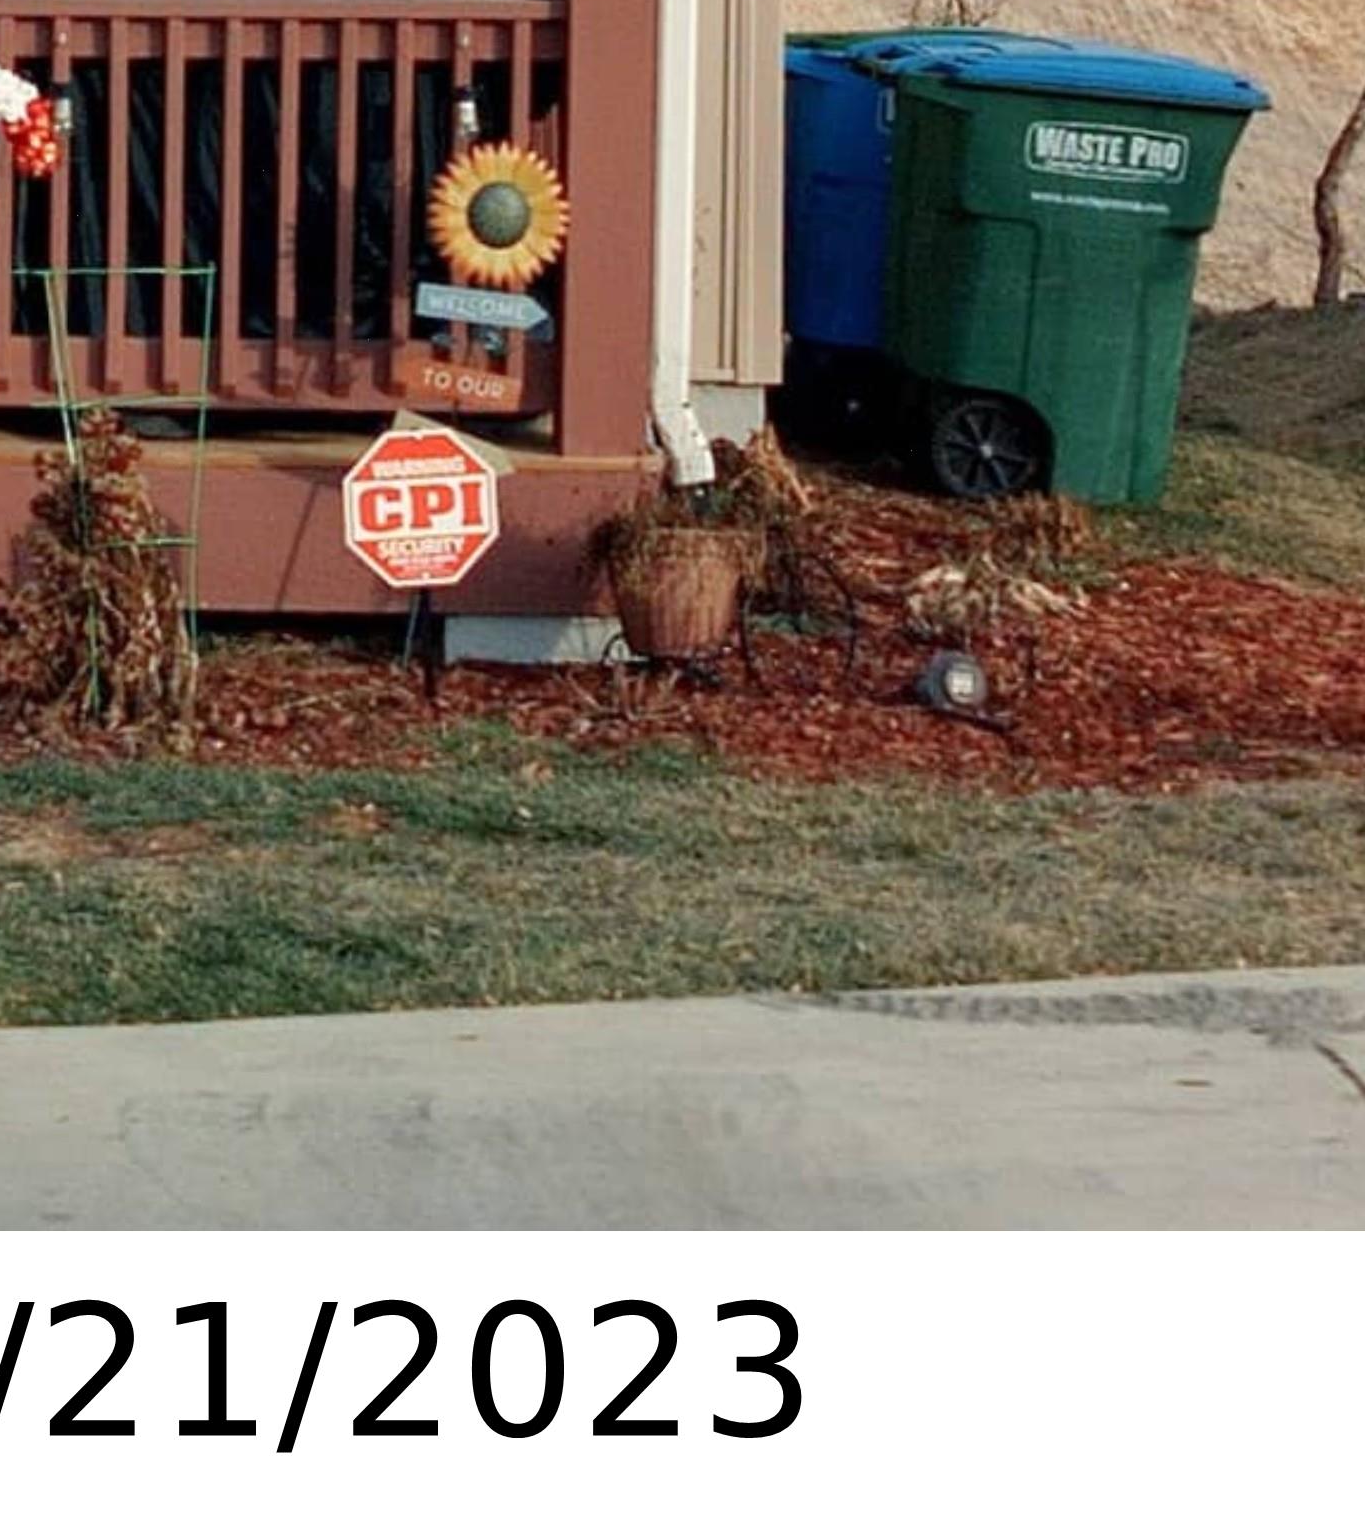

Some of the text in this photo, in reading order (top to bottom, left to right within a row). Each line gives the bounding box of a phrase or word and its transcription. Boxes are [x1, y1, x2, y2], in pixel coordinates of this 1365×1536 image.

[1035, 126, 1125, 164] WASTE
[1129, 135, 1180, 171] PRO
[422, 365, 452, 391] TO
[359, 481, 483, 533] CPI
